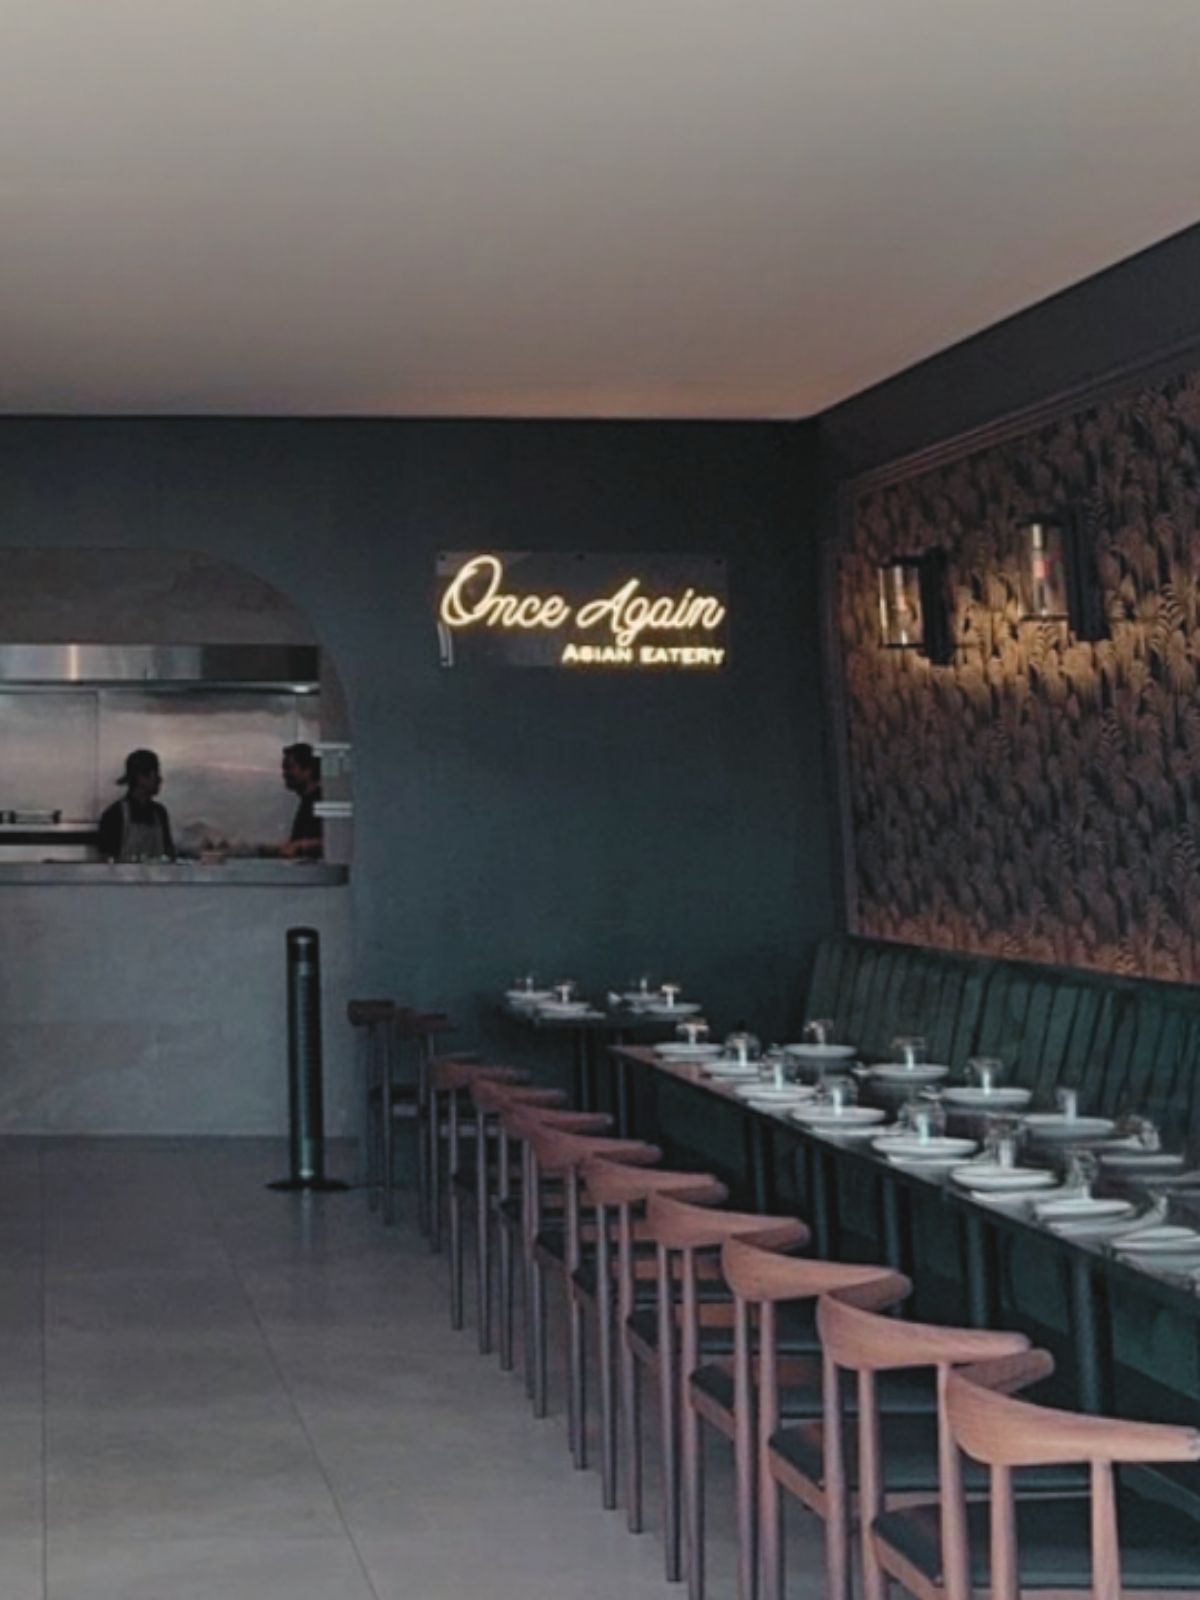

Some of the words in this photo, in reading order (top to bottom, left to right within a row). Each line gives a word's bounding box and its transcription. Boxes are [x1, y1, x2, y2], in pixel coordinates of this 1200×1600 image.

[441, 555, 570, 628] Once
[576, 577, 726, 646] Again
[561, 643, 633, 664] ASIAN
[640, 645, 725, 665] EATERY
